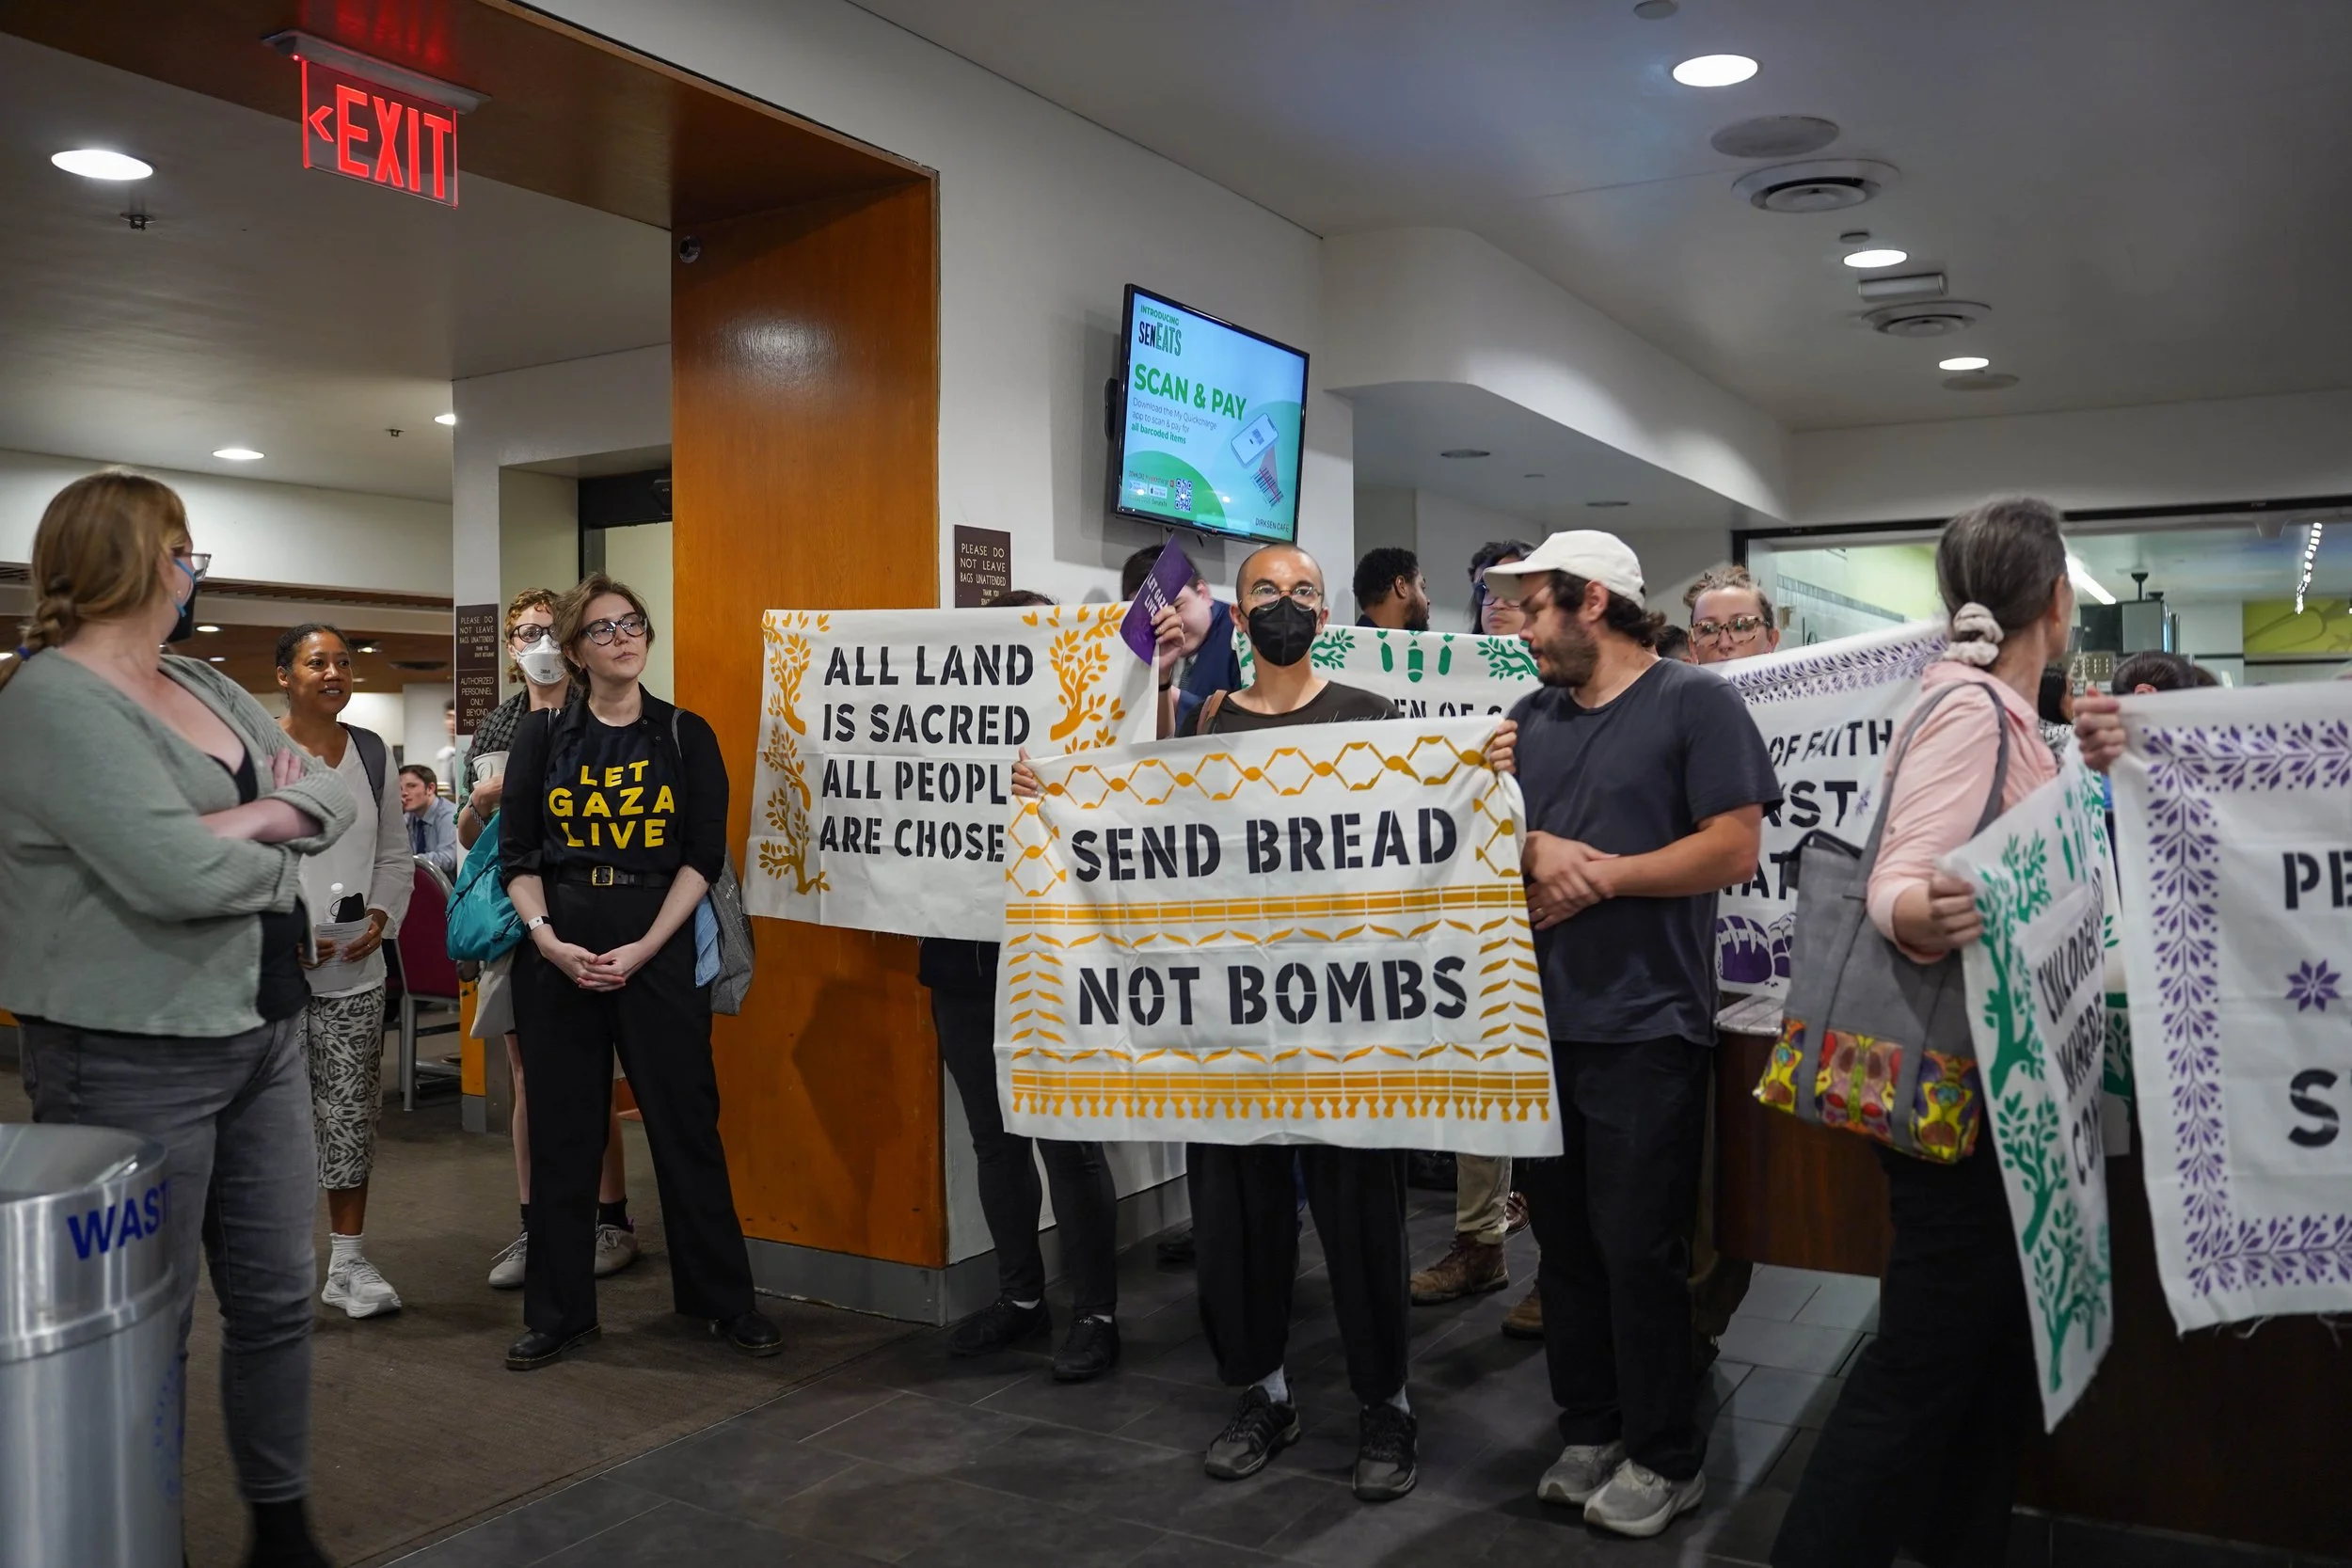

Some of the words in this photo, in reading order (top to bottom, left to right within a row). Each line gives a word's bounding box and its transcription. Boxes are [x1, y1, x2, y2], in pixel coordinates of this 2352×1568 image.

[336, 84, 453, 199] EXIT
[1140, 304, 1180, 326] INTRODUCING
[1138, 321, 1182, 356] SENEATS
[1134, 363, 1189, 404] SCAN
[1193, 383, 1206, 410] &
[1211, 388, 1248, 421] PAY
[1132, 411, 1144, 420] app
[1144, 415, 1152, 423] to
[1152, 416, 1166, 426] scan
[1167, 420, 1170, 428] &
[1170, 422, 1183, 433] pay
[1133, 397, 1163, 414] Download
[1163, 406, 1174, 417] the
[1174, 409, 1183, 421] My
[1183, 412, 1217, 431] Quickcharge
[1131, 422, 1139, 432] all
[1139, 424, 1169, 440] barcoded
[1169, 434, 1187, 444] items
[1255, 517, 1277, 531] DIRKSEN
[960, 557, 977, 569] NOT
[982, 560, 1006, 572] LEAVE
[961, 543, 988, 557] PLEASE
[993, 546, 1005, 559] DO
[960, 572, 974, 583] BAGS
[976, 574, 1007, 587] UNATTENDED
[1147, 573, 1158, 593] LET
[1153, 588, 1168, 610] GAZ
[460, 616, 480, 625] PLEASE
[484, 615, 494, 624] DO
[1144, 594, 1157, 618] LIVE
[470, 635, 495, 643] UNATTENDED
[461, 676, 495, 685] AUTHORIZED
[824, 645, 899, 686] ALL
[916, 644, 1034, 686] LAND
[461, 688, 493, 696] PERSONNEL
[469, 698, 485, 706] ONLY
[823, 704, 856, 742] IS
[869, 704, 1030, 746] SACRED
[1768, 734, 1802, 768] OF
[1801, 719, 1893, 763] FAITH
[580, 760, 649, 787] LET
[822, 759, 882, 800] ALL
[896, 761, 1008, 805] PEOPL
[548, 784, 675, 817] GAZA
[562, 819, 666, 849] LIVE
[819, 816, 882, 855] ARE
[895, 818, 1005, 863] CHOSE
[1071, 823, 1222, 882] SEND
[1246, 808, 1457, 875] BREAD
[1079, 961, 1200, 1026] NOT
[1228, 956, 1468, 1025] BOMBS
[2287, 1068, 2352, 1148] S
[67, 1179, 170, 1261] WAST
